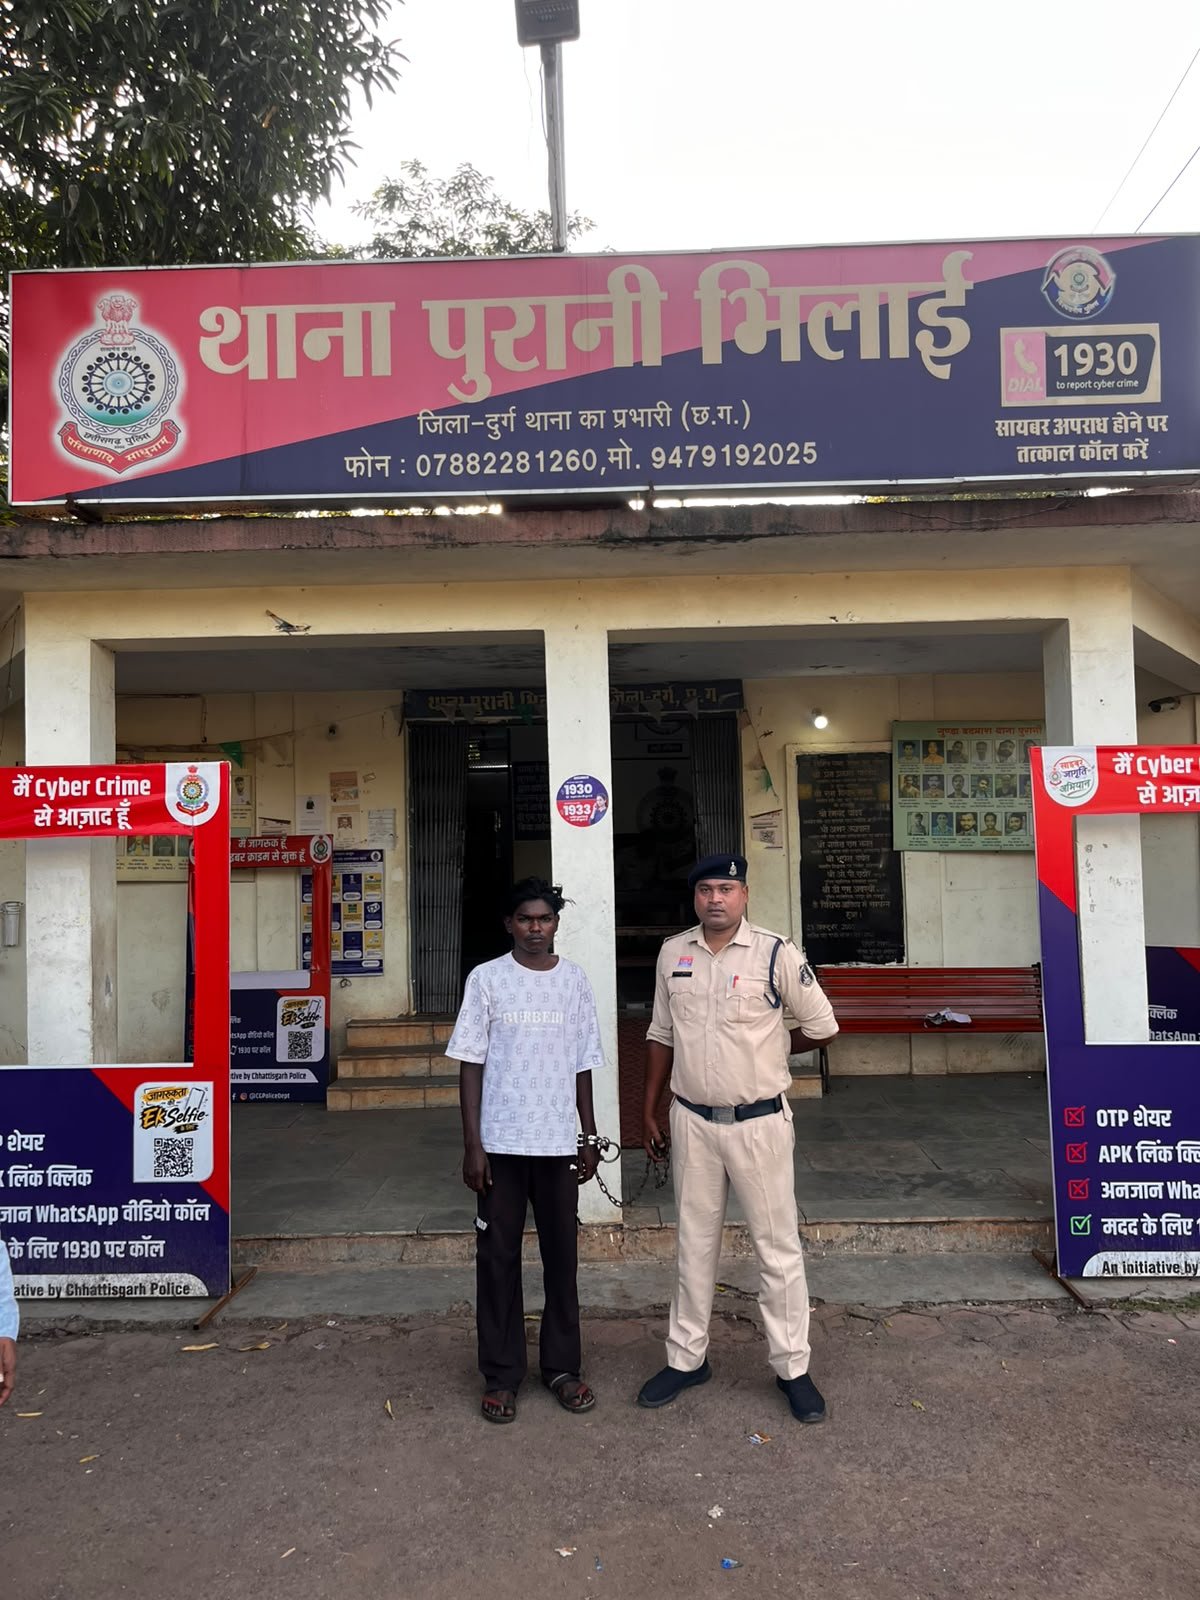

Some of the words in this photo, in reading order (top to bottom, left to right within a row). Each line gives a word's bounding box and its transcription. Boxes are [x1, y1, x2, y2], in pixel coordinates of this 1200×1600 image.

[199, 301, 396, 380] थाना
[422, 264, 668, 403] पुरानी
[694, 250, 974, 380] भिलाई
[1053, 341, 1138, 377] 1930
[1007, 377, 1043, 393] DIAL
[1056, 380, 1065, 389] to
[1066, 379, 1092, 391] report
[1093, 378, 1117, 390] cyber
[1117, 378, 1139, 388] crime
[525, 411, 572, 432] थाना
[578, 409, 606, 430] का
[613, 400, 672, 429] प्रभारी
[681, 400, 751, 432] (छ.ग.)
[995, 419, 1051, 437] सायबर
[1053, 416, 1109, 435] अपराध
[1112, 412, 1143, 434] होने
[1146, 415, 1168, 432] पर
[344, 447, 392, 478] फोन
[651, 442, 818, 469] 9479192025
[1016, 444, 1076, 463] तत्काल
[1078, 440, 1119, 460] कॉल
[1122, 438, 1149, 460] करें
[1112, 752, 1134, 775] मैं
[1136, 755, 1194, 778] Cyber
[12, 773, 34, 797] मैं
[35, 777, 90, 801] Cyber
[95, 775, 151, 797] Crime
[563, 783, 593, 795] 1930
[1136, 781, 1157, 804] से
[1162, 785, 1200, 807] आज़
[34, 804, 54, 827] से
[57, 807, 114, 829] आज़ाद
[115, 798, 132, 830] हूँ
[563, 804, 592, 816] 1933
[271, 849, 280, 860] से
[1149, 1030, 1196, 1041] hatsApp
[243, 1072, 251, 1080] by
[252, 1071, 288, 1080] Chhattisgarh
[289, 1071, 306, 1080] Police
[142, 1107, 165, 1129] Ek
[163, 1106, 205, 1128] Selfie
[1096, 1109, 1129, 1127] OTP
[1133, 1105, 1172, 1127] शेयर
[7, 1130, 45, 1151] शेयर
[1099, 1145, 1133, 1163] APK
[1135, 1139, 1173, 1163] लिंक
[8, 1164, 44, 1187] लिंक
[46, 1165, 93, 1187] क्लिक
[1101, 1181, 1164, 1199] अनजान
[36, 1203, 119, 1226] WhatsApp
[122, 1199, 172, 1222] वीडियो
[174, 1198, 211, 1222] कॉल
[1101, 1217, 1139, 1235] मदद
[1140, 1212, 1158, 1236] के
[1160, 1213, 1194, 1236] लिए
[8, 1236, 25, 1260] के
[27, 1236, 59, 1260] लिए
[62, 1240, 100, 1260] 1930
[104, 1240, 126, 1259] पर
[129, 1235, 165, 1258] कॉल
[1102, 1260, 1118, 1274] An
[1122, 1260, 1180, 1275] initiative
[1184, 1260, 1199, 1277] by
[14, 1284, 44, 1297] ative
[48, 1282, 62, 1299] by
[66, 1282, 146, 1298] Chhattisgarh
[151, 1282, 190, 1296] Police
